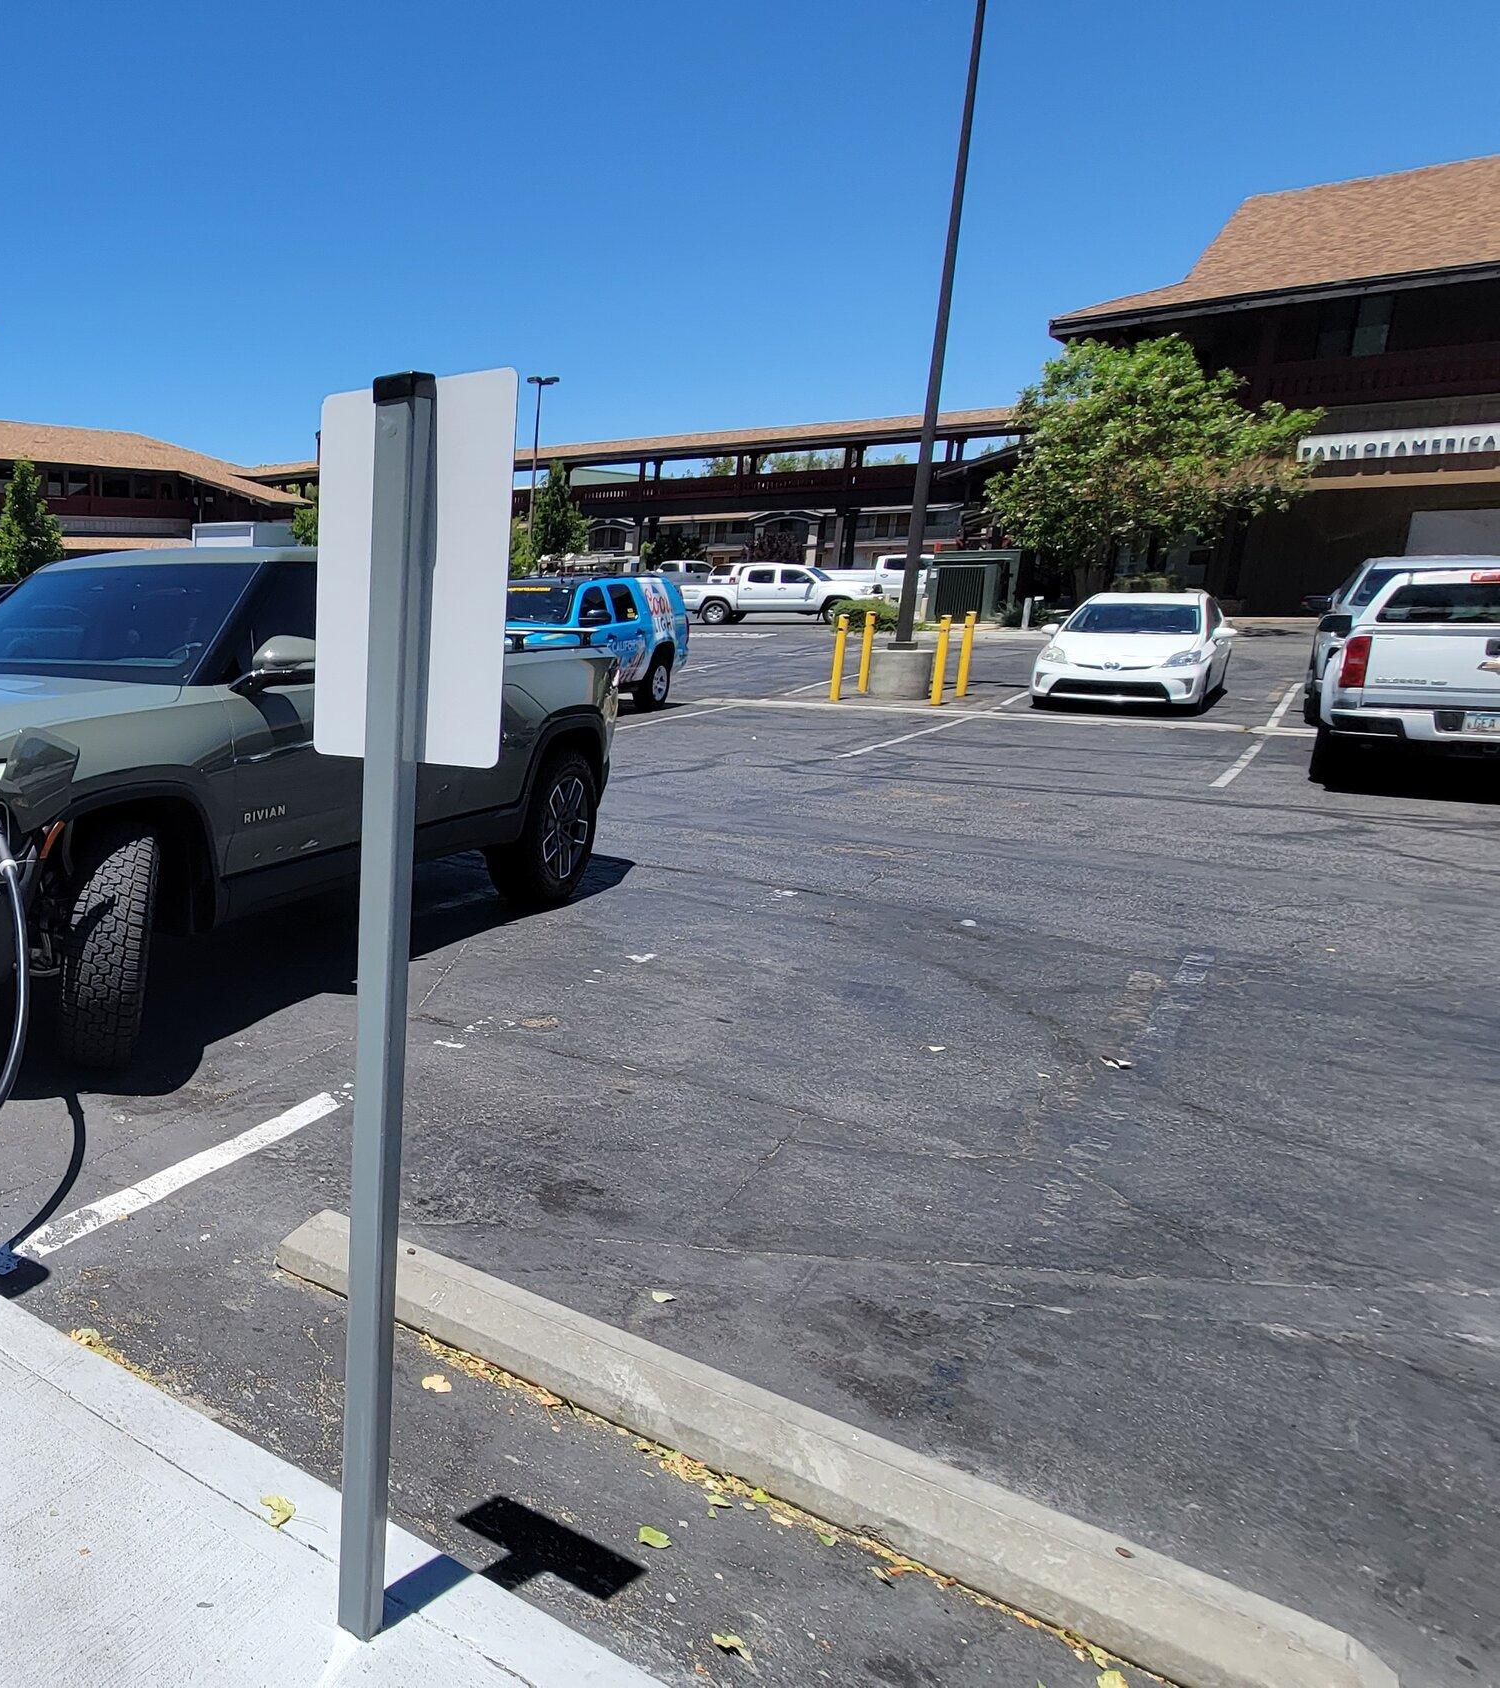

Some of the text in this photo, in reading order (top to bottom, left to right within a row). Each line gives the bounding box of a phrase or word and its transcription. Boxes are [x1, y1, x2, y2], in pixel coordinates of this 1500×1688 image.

[1363, 442, 1390, 458] OF
[1394, 435, 1496, 456] AMERICA
[243, 805, 286, 824] RIVIAN
